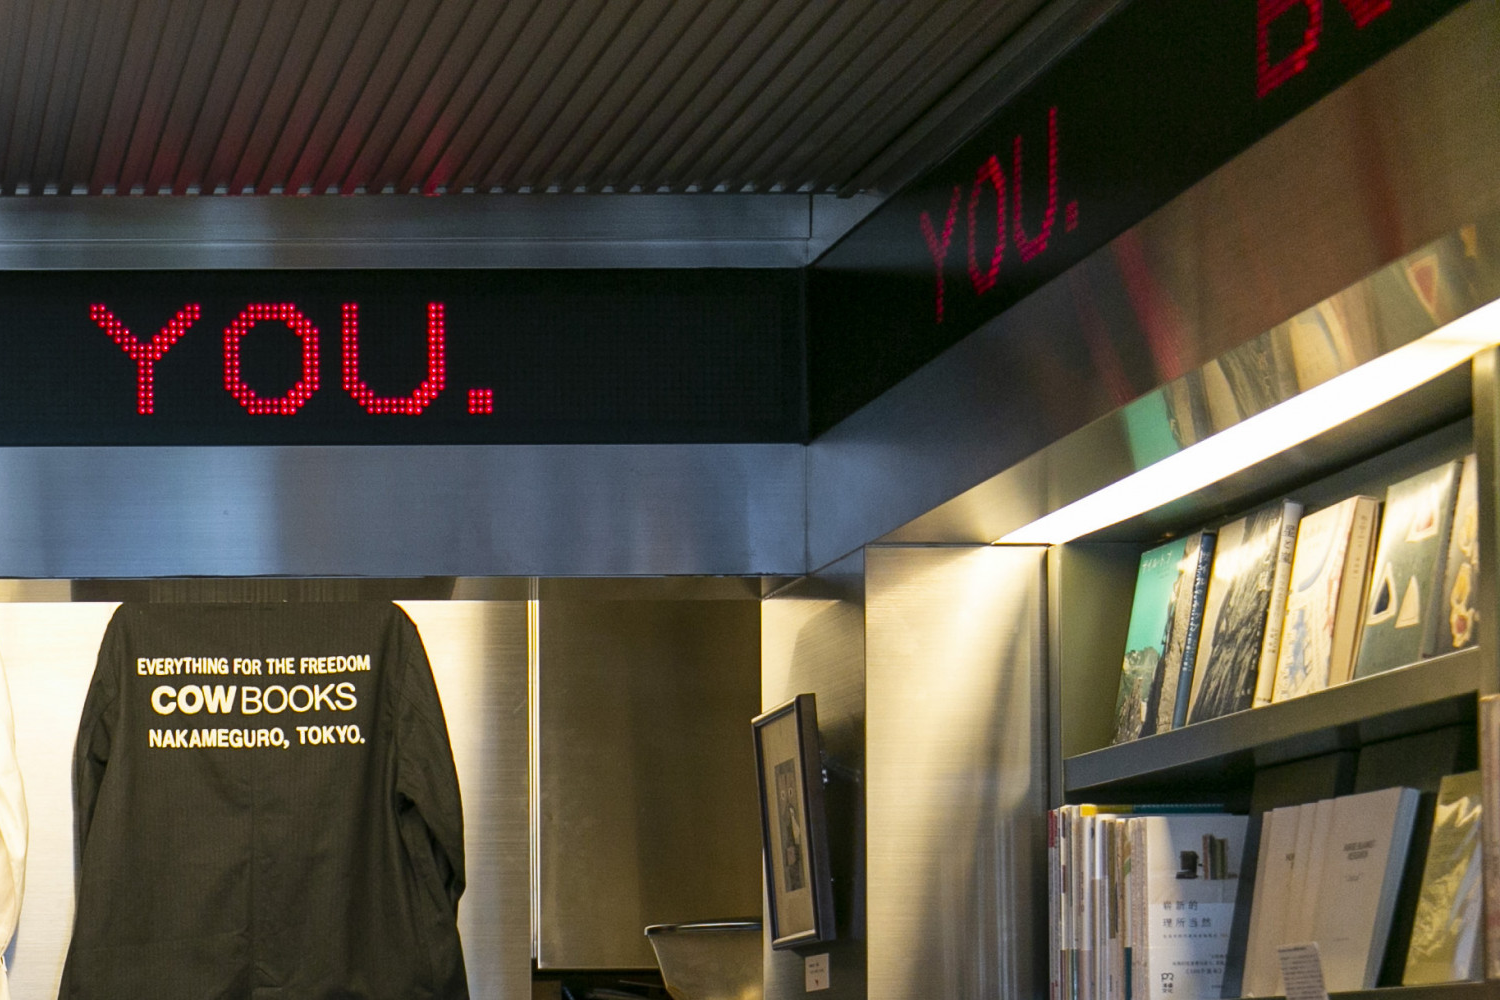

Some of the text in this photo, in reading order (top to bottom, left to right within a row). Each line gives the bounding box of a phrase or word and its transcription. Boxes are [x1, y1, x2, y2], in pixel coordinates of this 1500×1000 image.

[920, 107, 1079, 323] YOU.
[88, 301, 496, 417] YOU.
[137, 654, 372, 676] EVERYTHING FOR THE FREEDOM
[148, 724, 367, 749] NAKAMEGURO, TOKYO.
